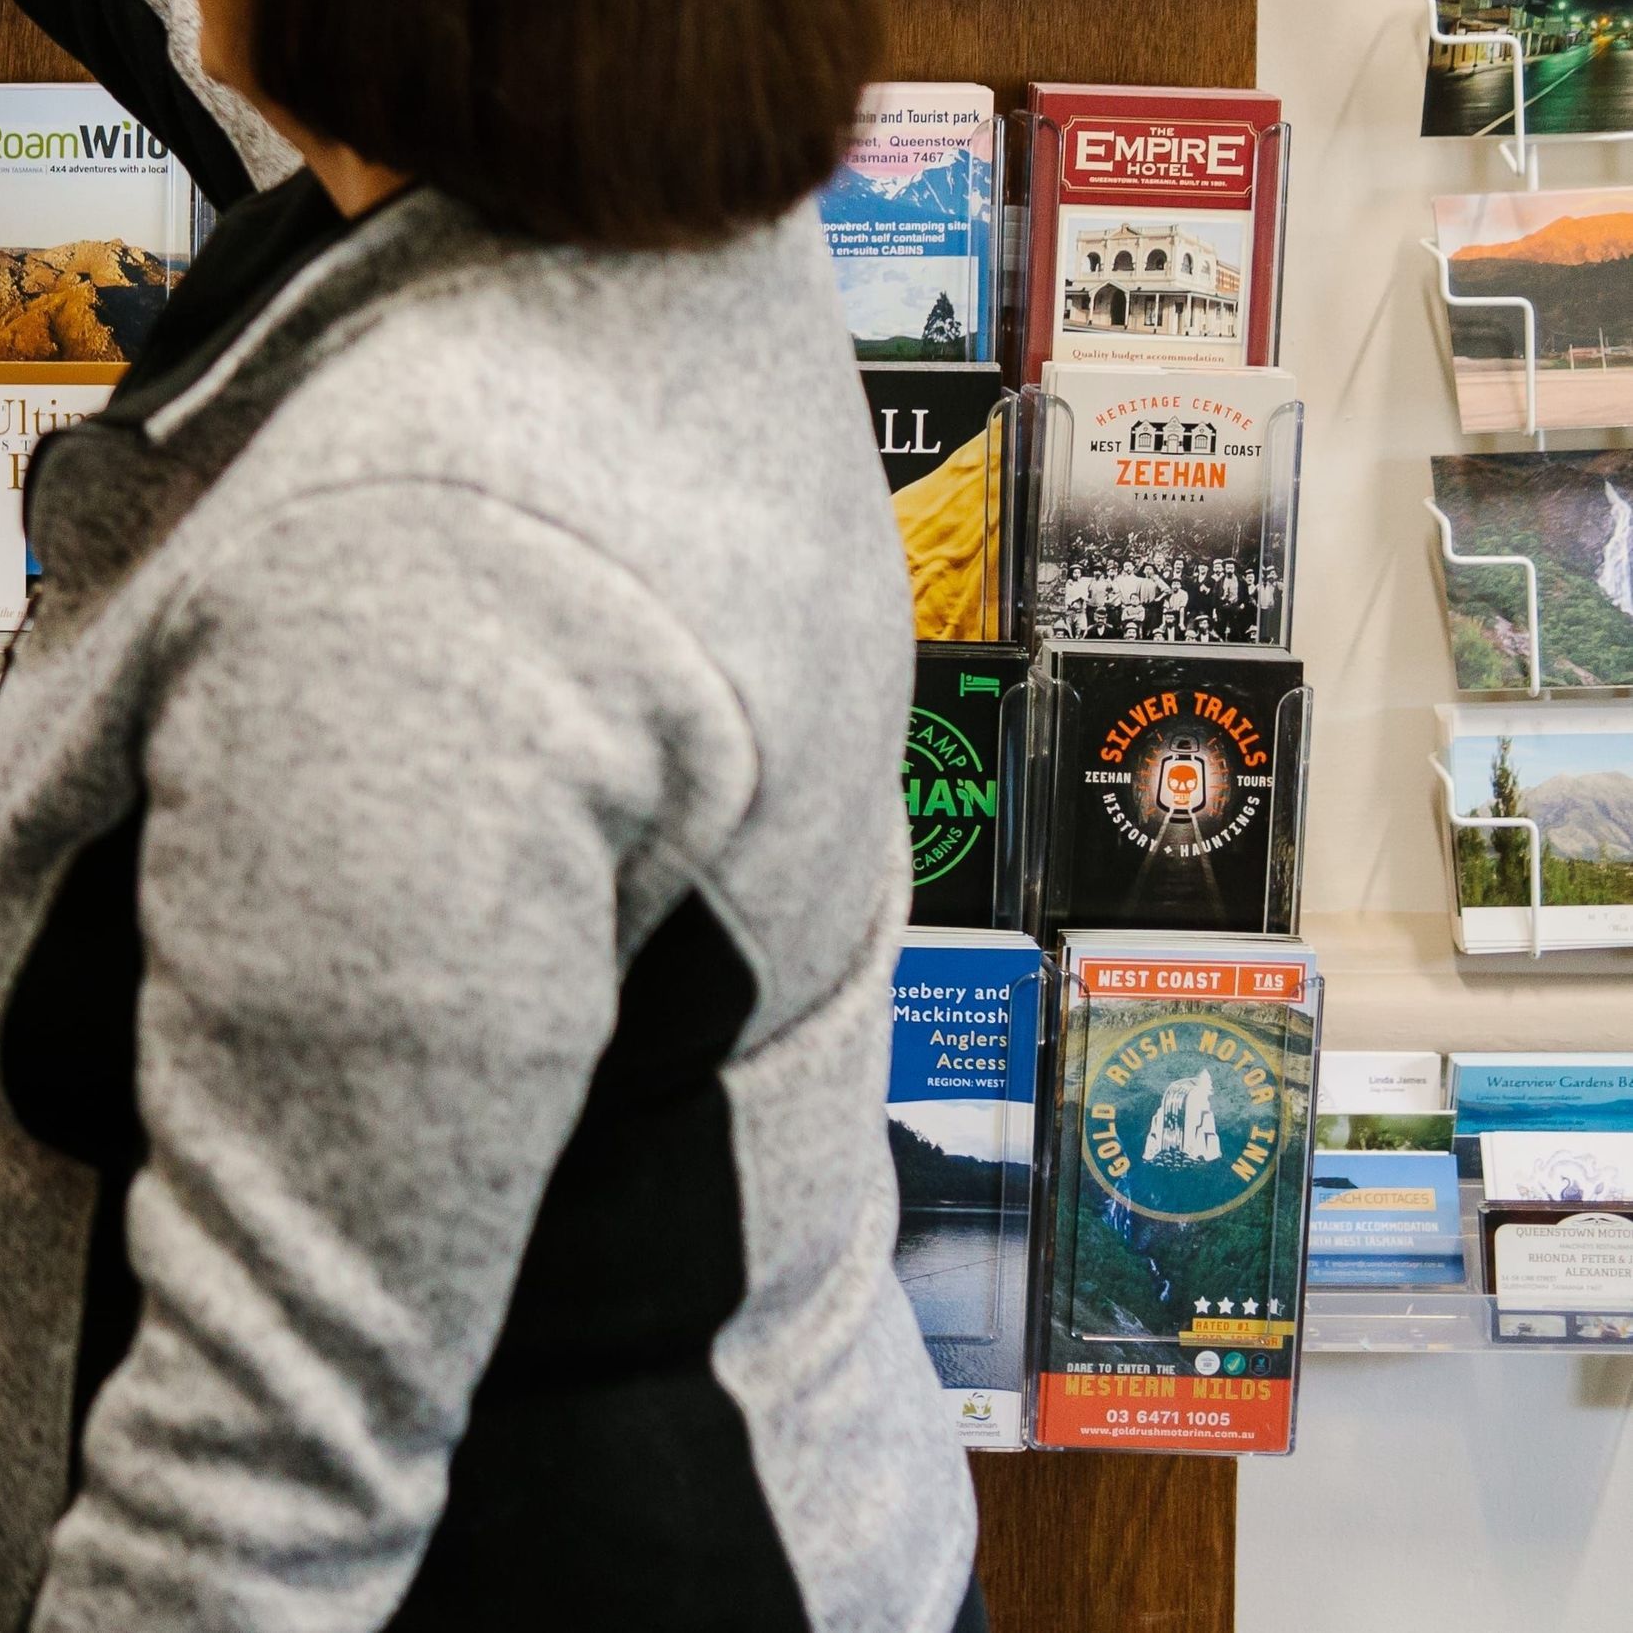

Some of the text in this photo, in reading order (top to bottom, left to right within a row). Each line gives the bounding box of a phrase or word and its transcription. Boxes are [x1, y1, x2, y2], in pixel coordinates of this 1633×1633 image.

[1149, 127, 1175, 136] THE
[1075, 130, 1245, 175] EMPIRE
[1127, 162, 1193, 176] HOTEL
[1116, 459, 1226, 488] ZEEHAN
[893, 1005, 1009, 1024] Mackintosh
[930, 1030, 1008, 1050] Anglers
[936, 1053, 1006, 1071] Access
[1487, 1076, 1614, 1089] Waterview Gardens
[1319, 1192, 1430, 1206] BEACH COTTAGES
[1106, 1409, 1230, 1427] 03 6471 1005
